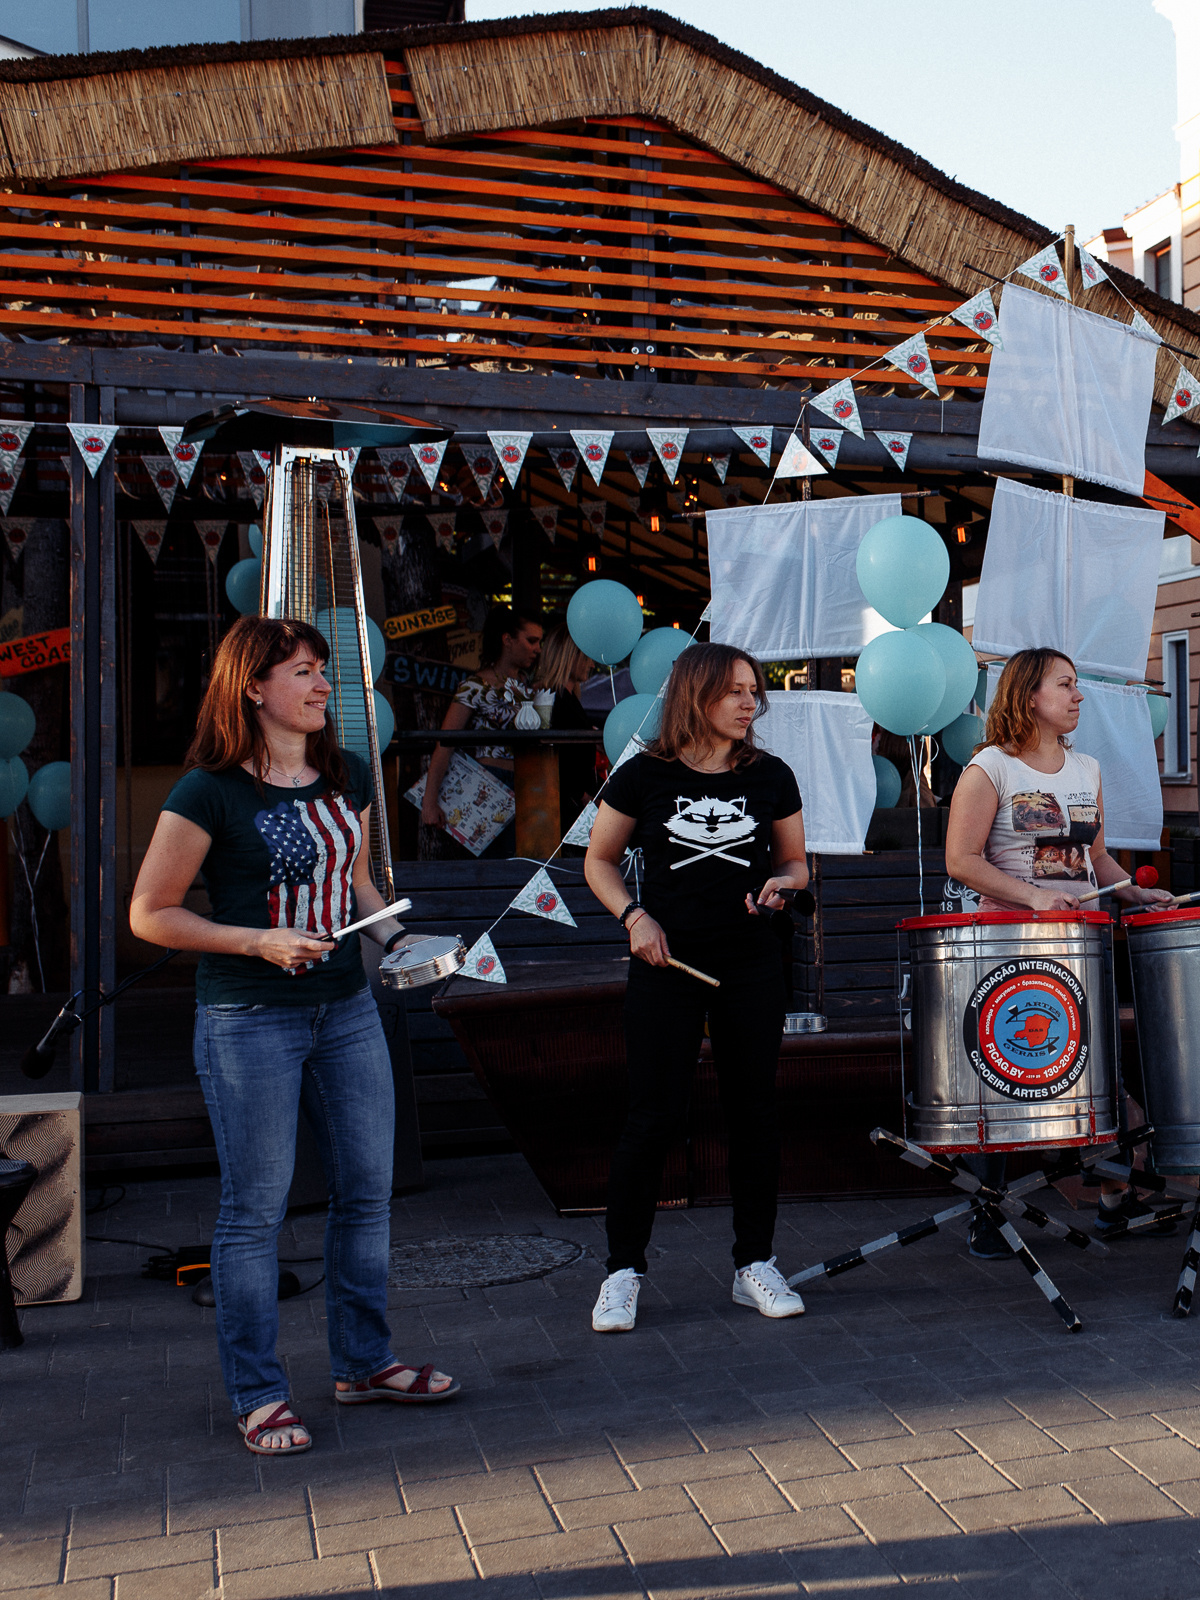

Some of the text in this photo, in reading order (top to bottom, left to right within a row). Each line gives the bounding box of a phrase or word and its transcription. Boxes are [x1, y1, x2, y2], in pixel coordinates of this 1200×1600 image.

[0, 635, 50, 661] WEST
[21, 641, 70, 668] COAS
[940, 901, 953, 912] 18
[971, 961, 1084, 1008] FUNDAÇÃO INTERNACIONAL
[1024, 1001, 1062, 1018] ARTES
[985, 1042, 1025, 1079] FICAG.BY
[1043, 1039, 1077, 1078] 130-20-33
[1003, 1042, 1046, 1057] GERAIS
[970, 1044, 1088, 1098] CAPOEIRA ARTES DAS GERAIS
